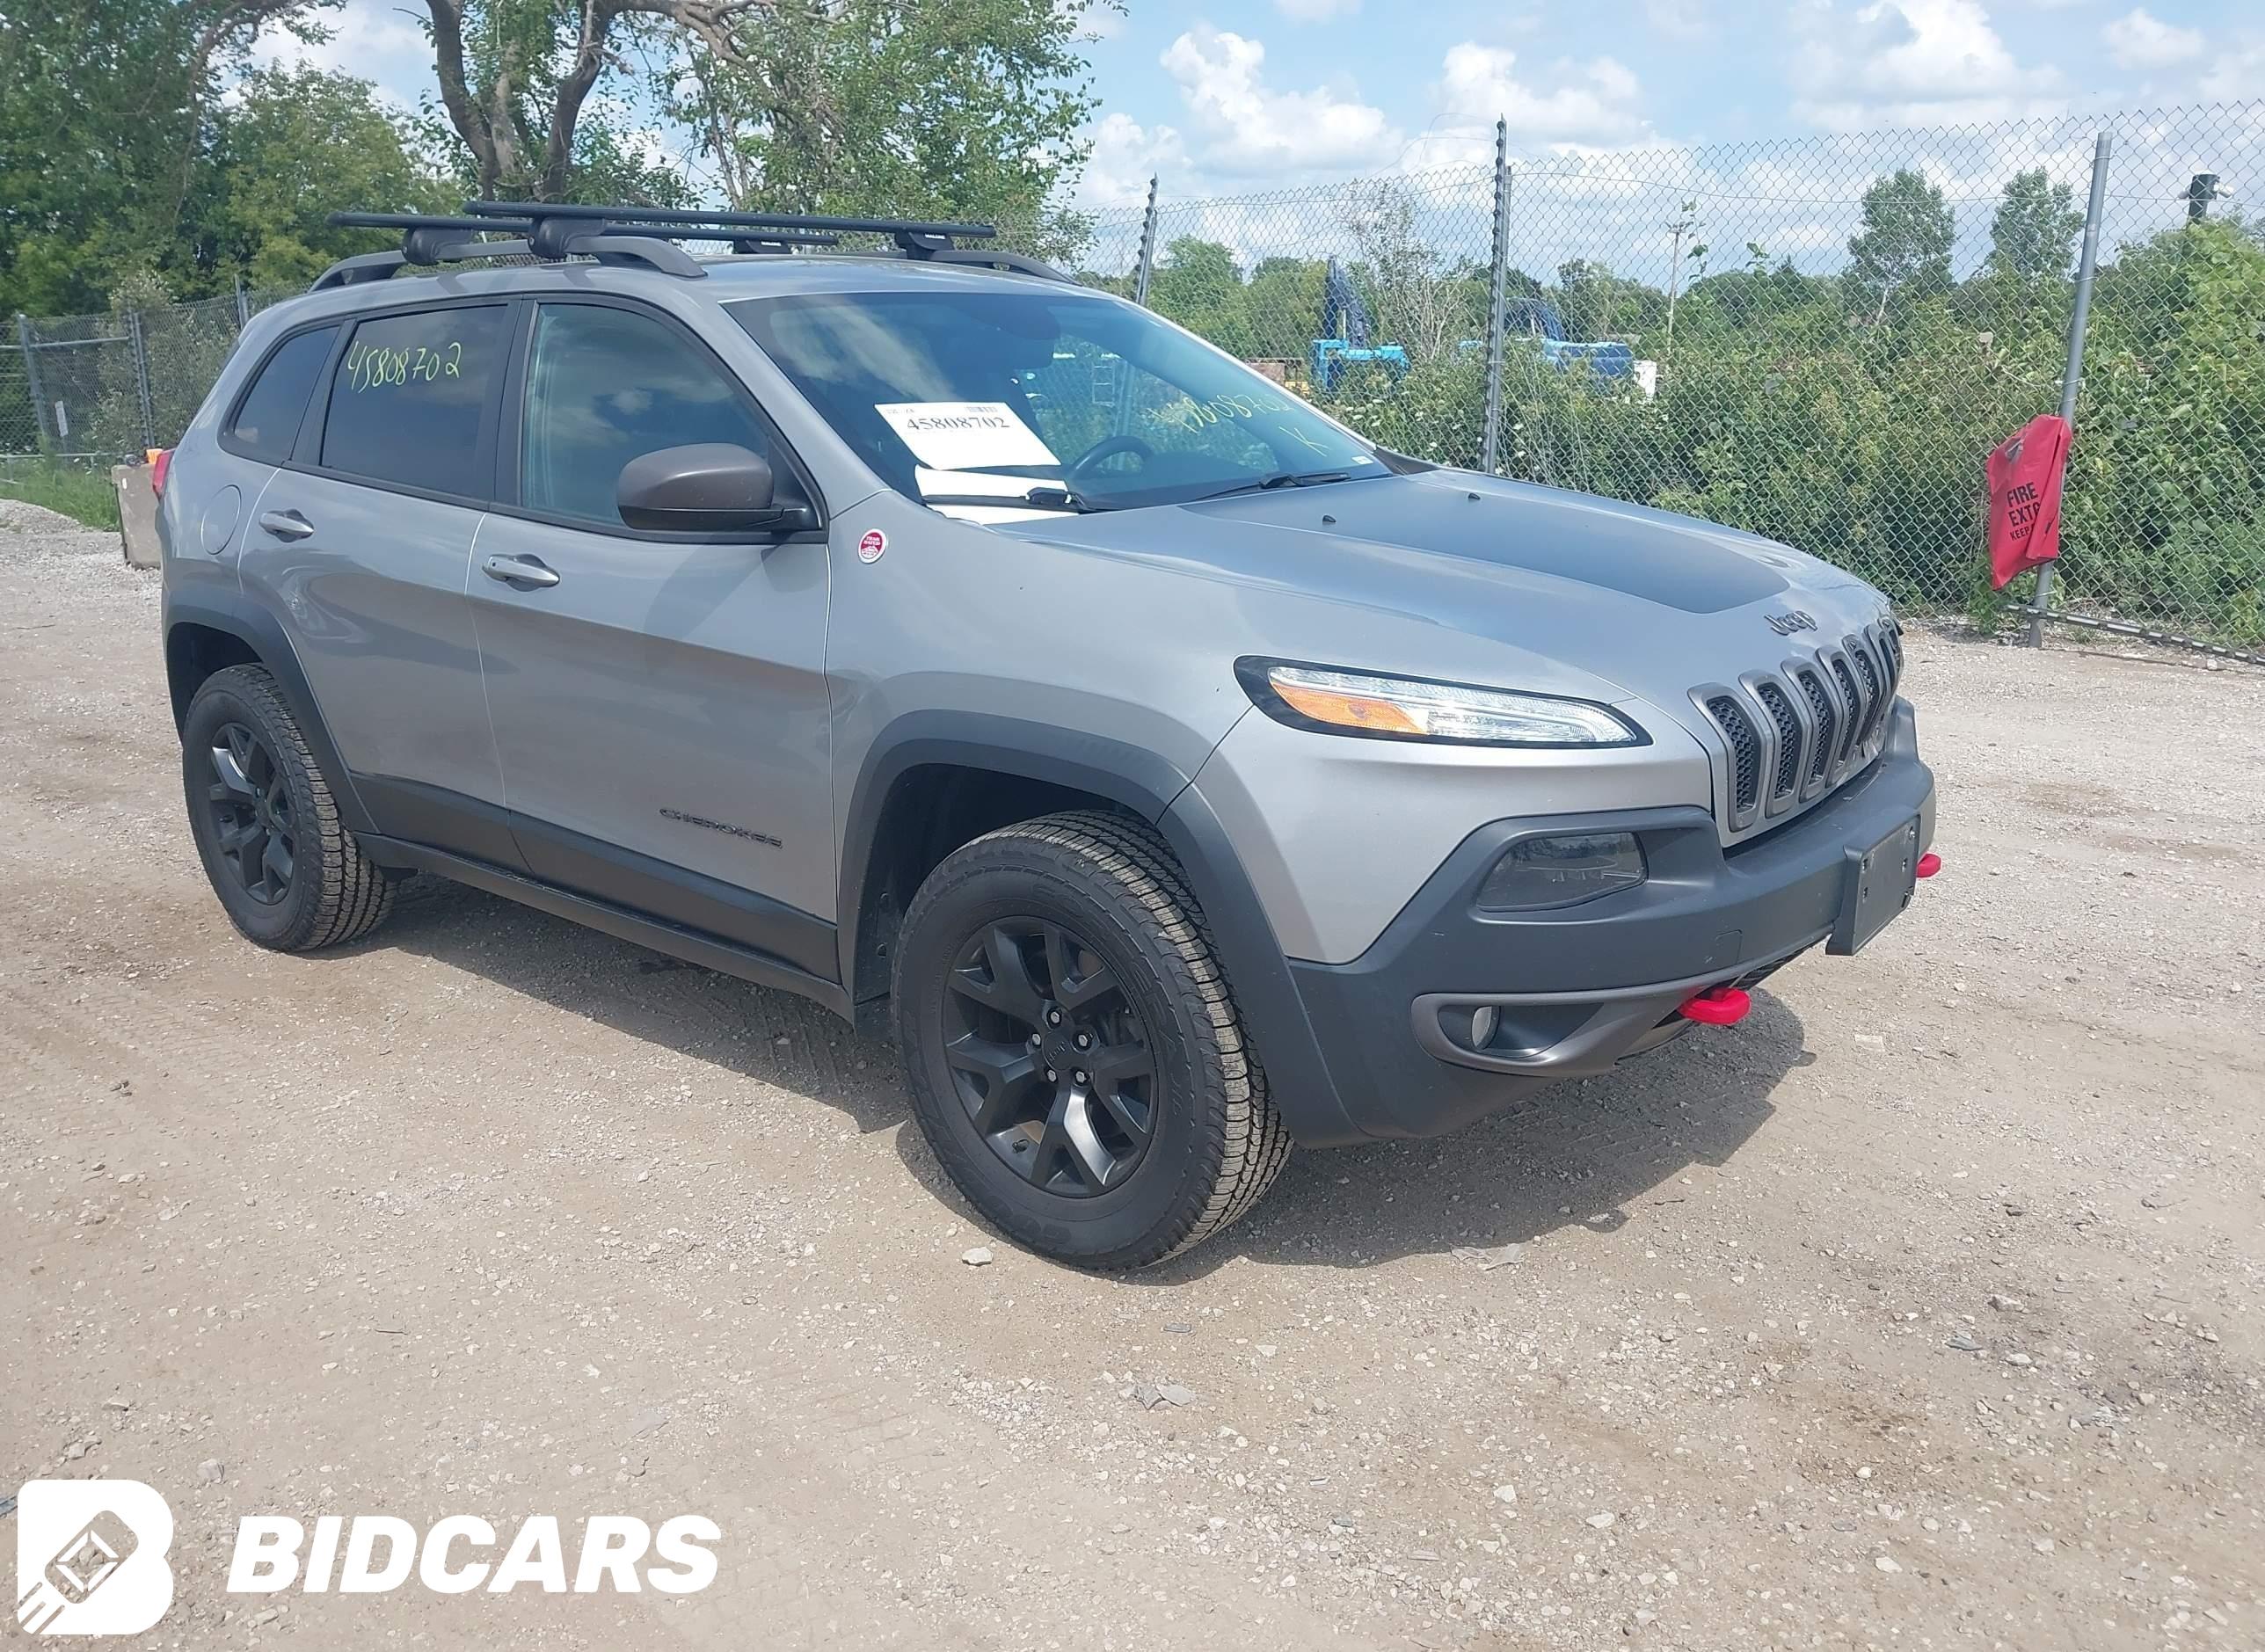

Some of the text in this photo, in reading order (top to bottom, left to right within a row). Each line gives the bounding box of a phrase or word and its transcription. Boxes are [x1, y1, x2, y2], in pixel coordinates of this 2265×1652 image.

[348, 340, 462, 394] 45808702
[907, 416, 1010, 431] 45808702
[2006, 482, 2039, 508] FIRE
[2010, 526, 2030, 542] KEEP
[1763, 610, 1818, 637] Jeep
[659, 808, 783, 849] CHEROKEE
